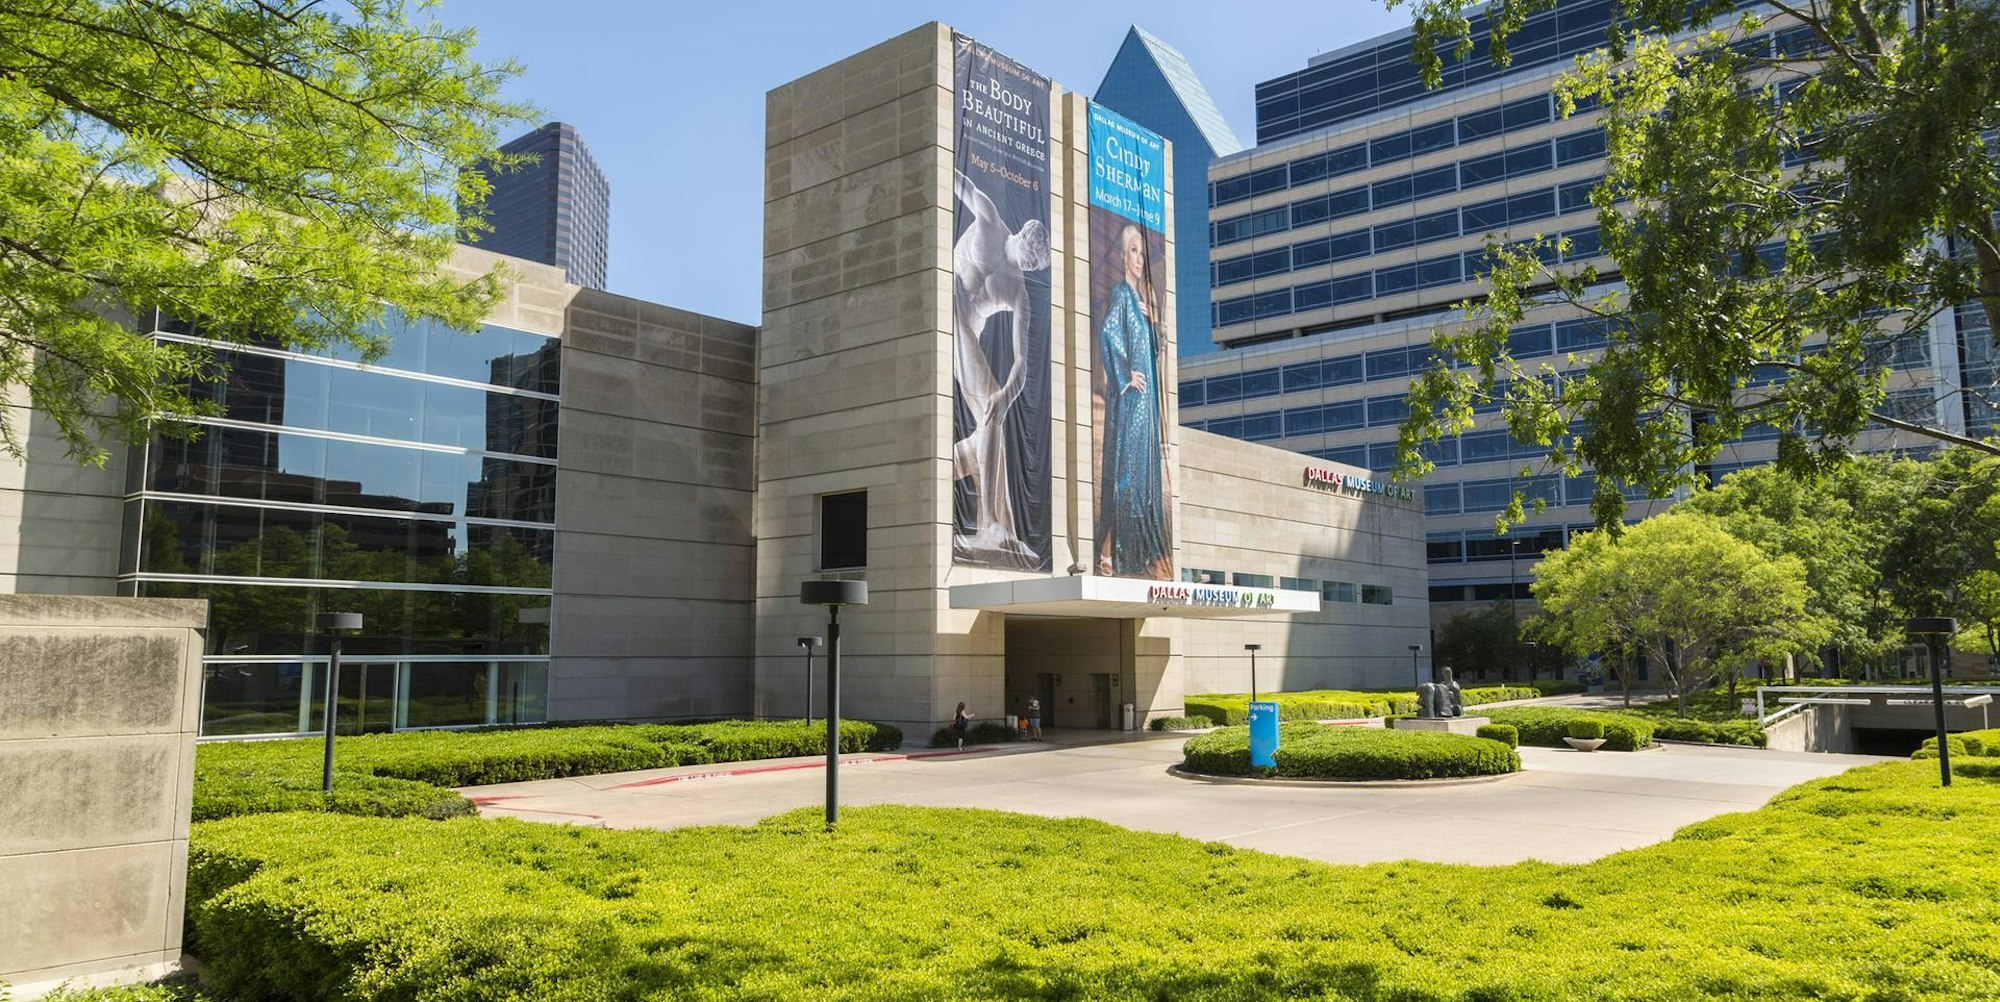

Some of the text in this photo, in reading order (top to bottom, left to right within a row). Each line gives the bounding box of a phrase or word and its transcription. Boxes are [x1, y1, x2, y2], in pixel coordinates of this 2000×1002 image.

[969, 78, 1032, 115] THE BODY
[962, 89, 1046, 145] BEAUTIFUL
[1093, 113, 1115, 129] DALLAS
[963, 117, 973, 128] IN
[976, 123, 1014, 146] ANCIENT
[1015, 141, 1046, 162] GREECE
[971, 153, 989, 173] May
[1032, 180, 1039, 192] 6
[1095, 186, 1121, 209] March
[1154, 212, 1160, 226] 9
[1305, 467, 1416, 501] DALLAS MUSEUM OF ART
[1150, 586, 1191, 600] DALLAS
[1193, 589, 1238, 602] MUSEUM
[1250, 704, 1273, 712] Parking
